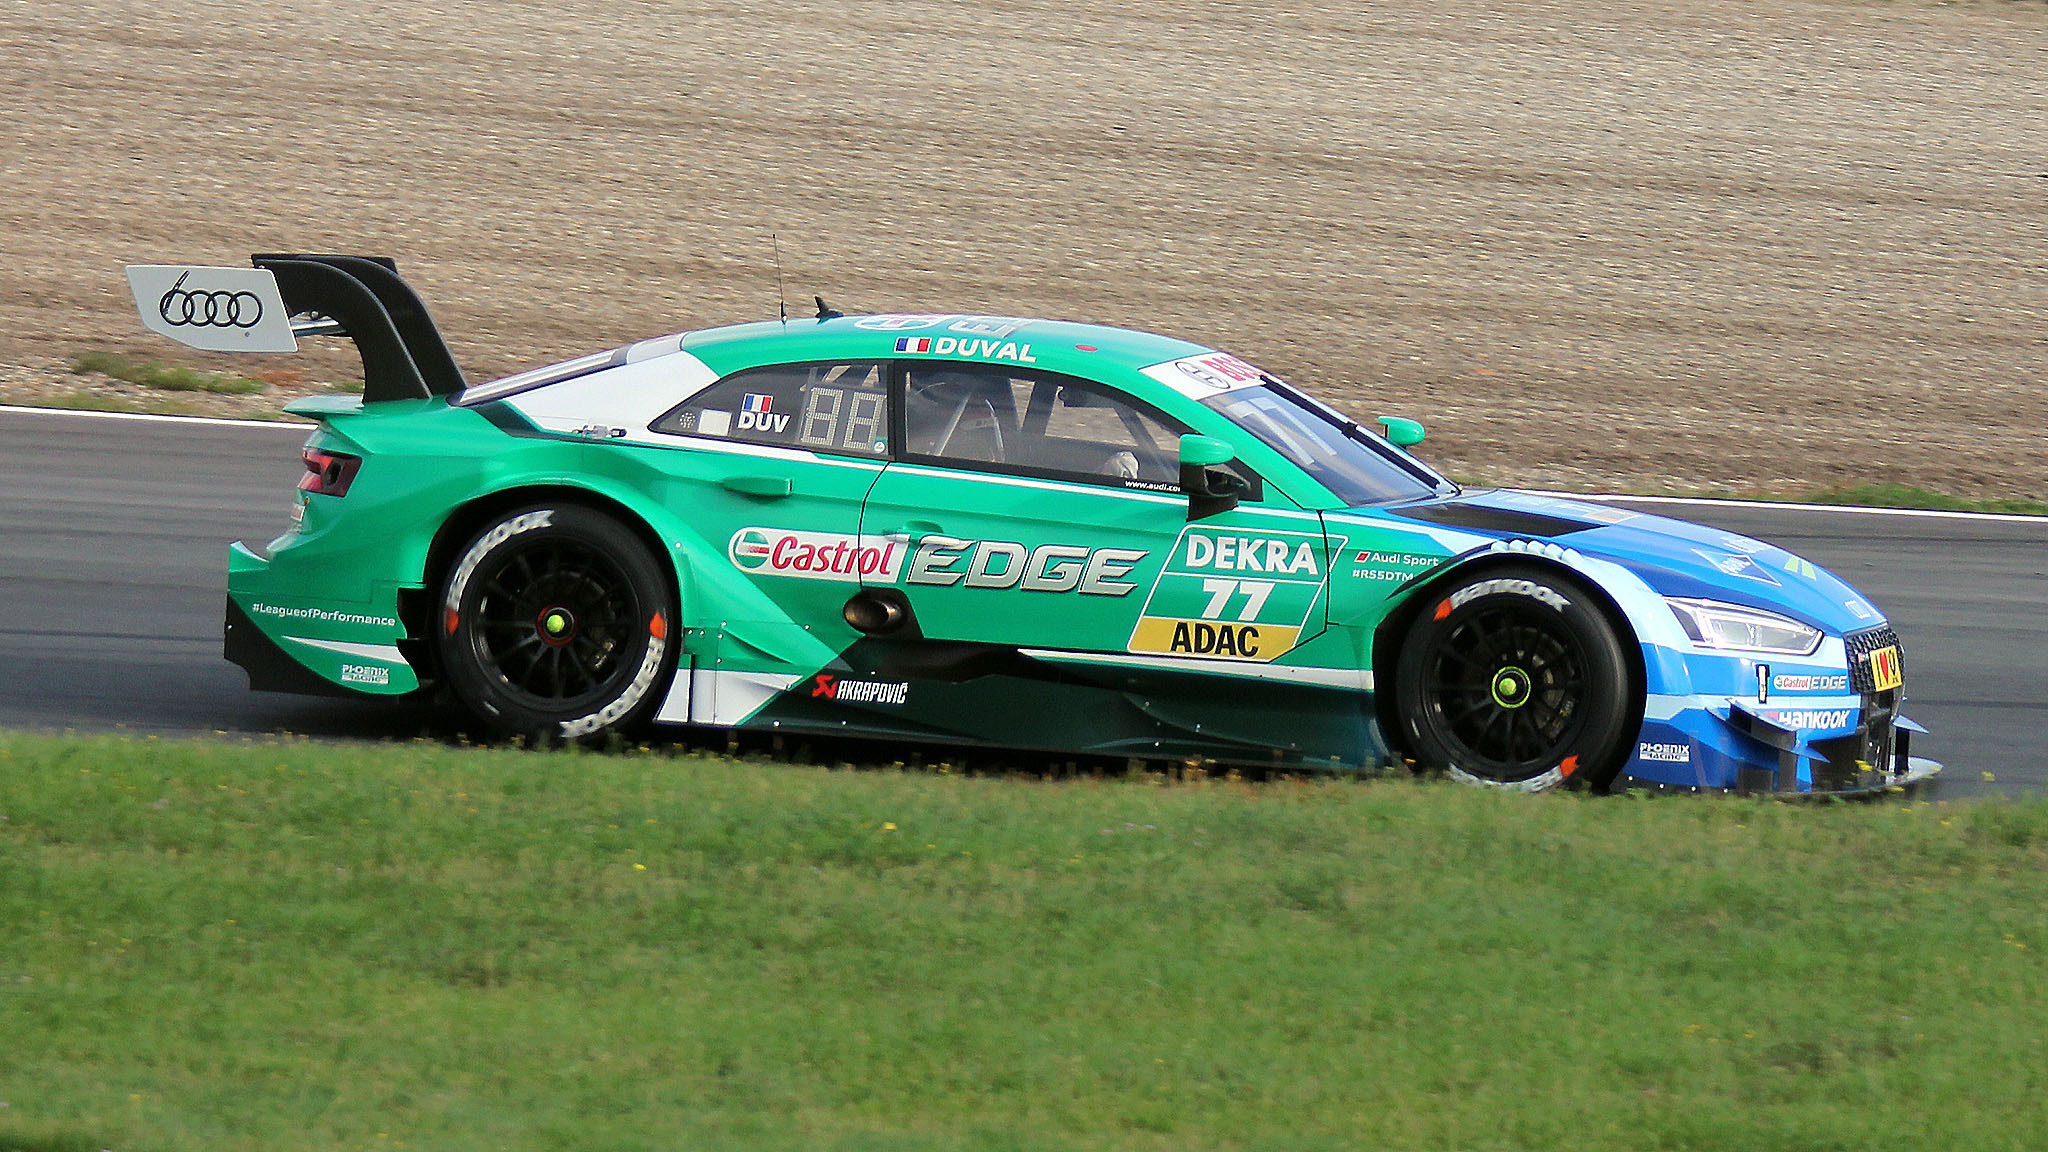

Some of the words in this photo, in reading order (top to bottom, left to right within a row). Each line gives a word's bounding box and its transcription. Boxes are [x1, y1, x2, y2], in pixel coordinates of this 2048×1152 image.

[935, 337, 1037, 363] DUVAL
[738, 412, 791, 433] DUV
[771, 535, 896, 576] Castrol
[906, 534, 1150, 596] EDGE
[1185, 534, 1319, 575] DEKRA
[1371, 552, 1401, 564] Audi
[1402, 554, 1440, 567] Sport
[1352, 568, 1414, 582] #RS5DTM
[1201, 578, 1276, 622] 77
[252, 603, 396, 627] #LeagueofPerformance
[1170, 621, 1260, 658] ADAC
[1783, 677, 1809, 689] Castrol
[1811, 676, 1848, 689] EDGE
